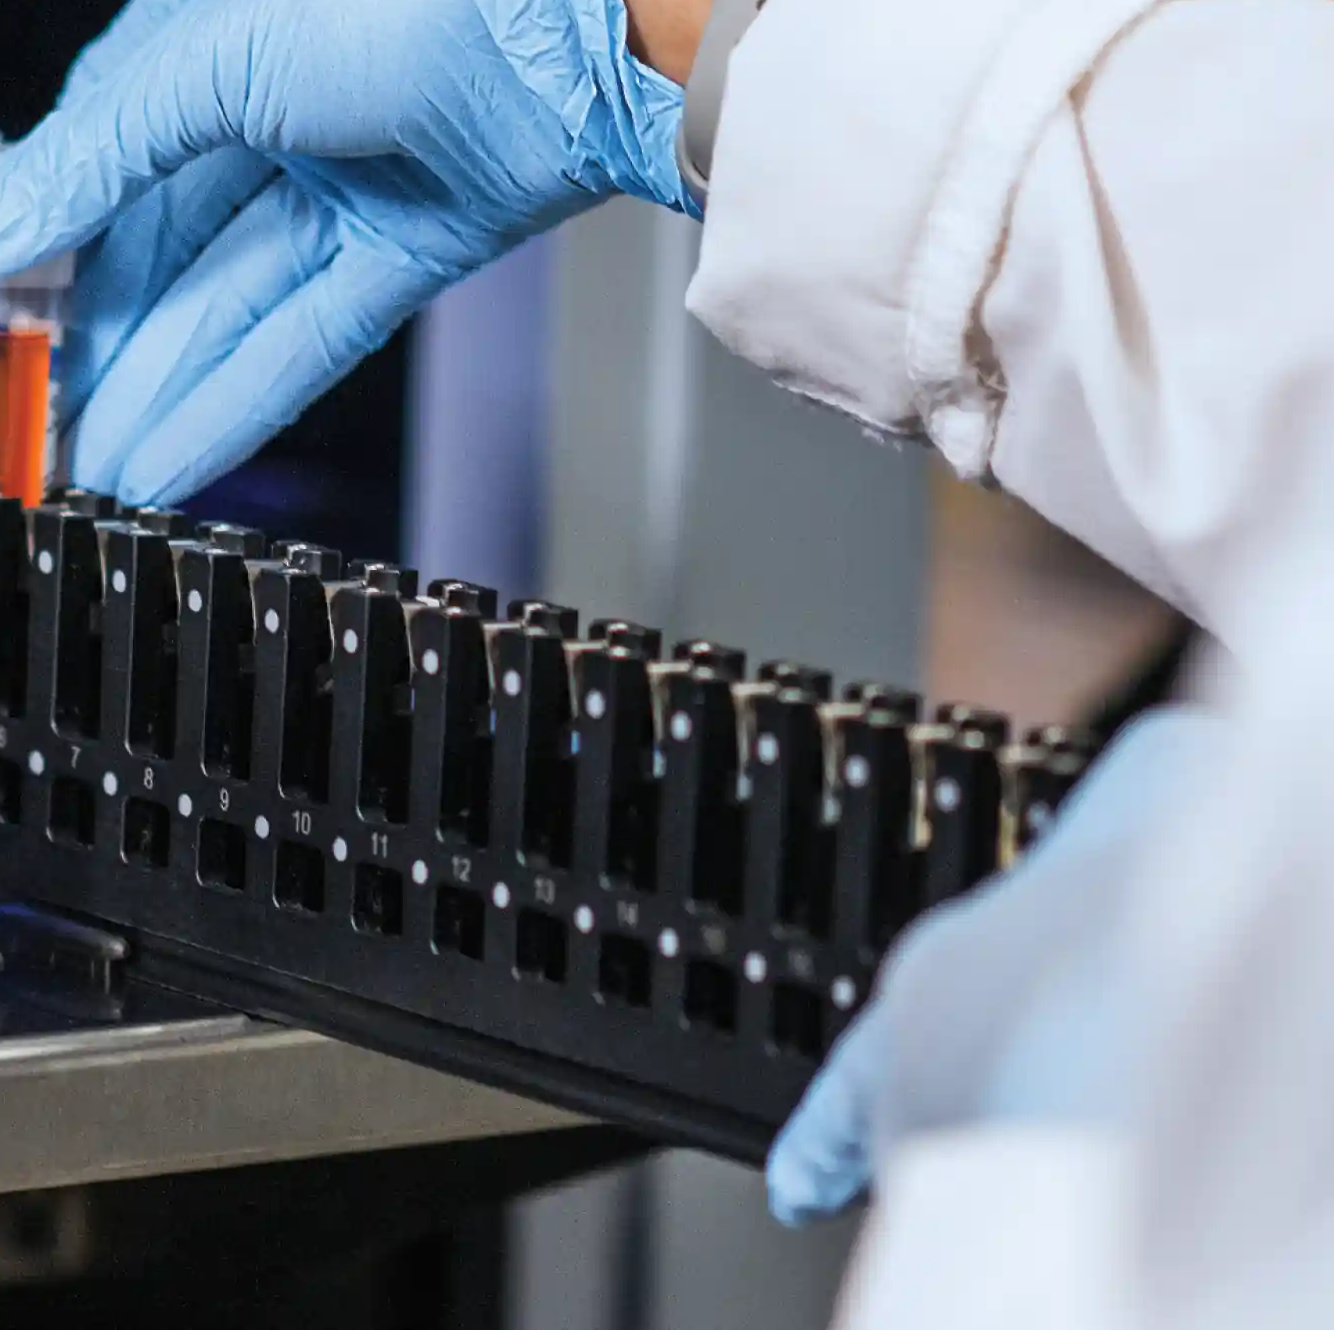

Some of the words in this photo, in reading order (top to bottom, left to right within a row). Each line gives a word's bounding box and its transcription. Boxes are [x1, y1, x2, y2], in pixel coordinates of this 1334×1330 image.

[71, 745, 82, 769] 7
[143, 766, 154, 790] 8
[219, 787, 230, 812] 9
[292, 809, 312, 836] 10
[371, 832, 388, 859] 11
[451, 855, 472, 883] 12
[534, 877, 556, 905] 13
